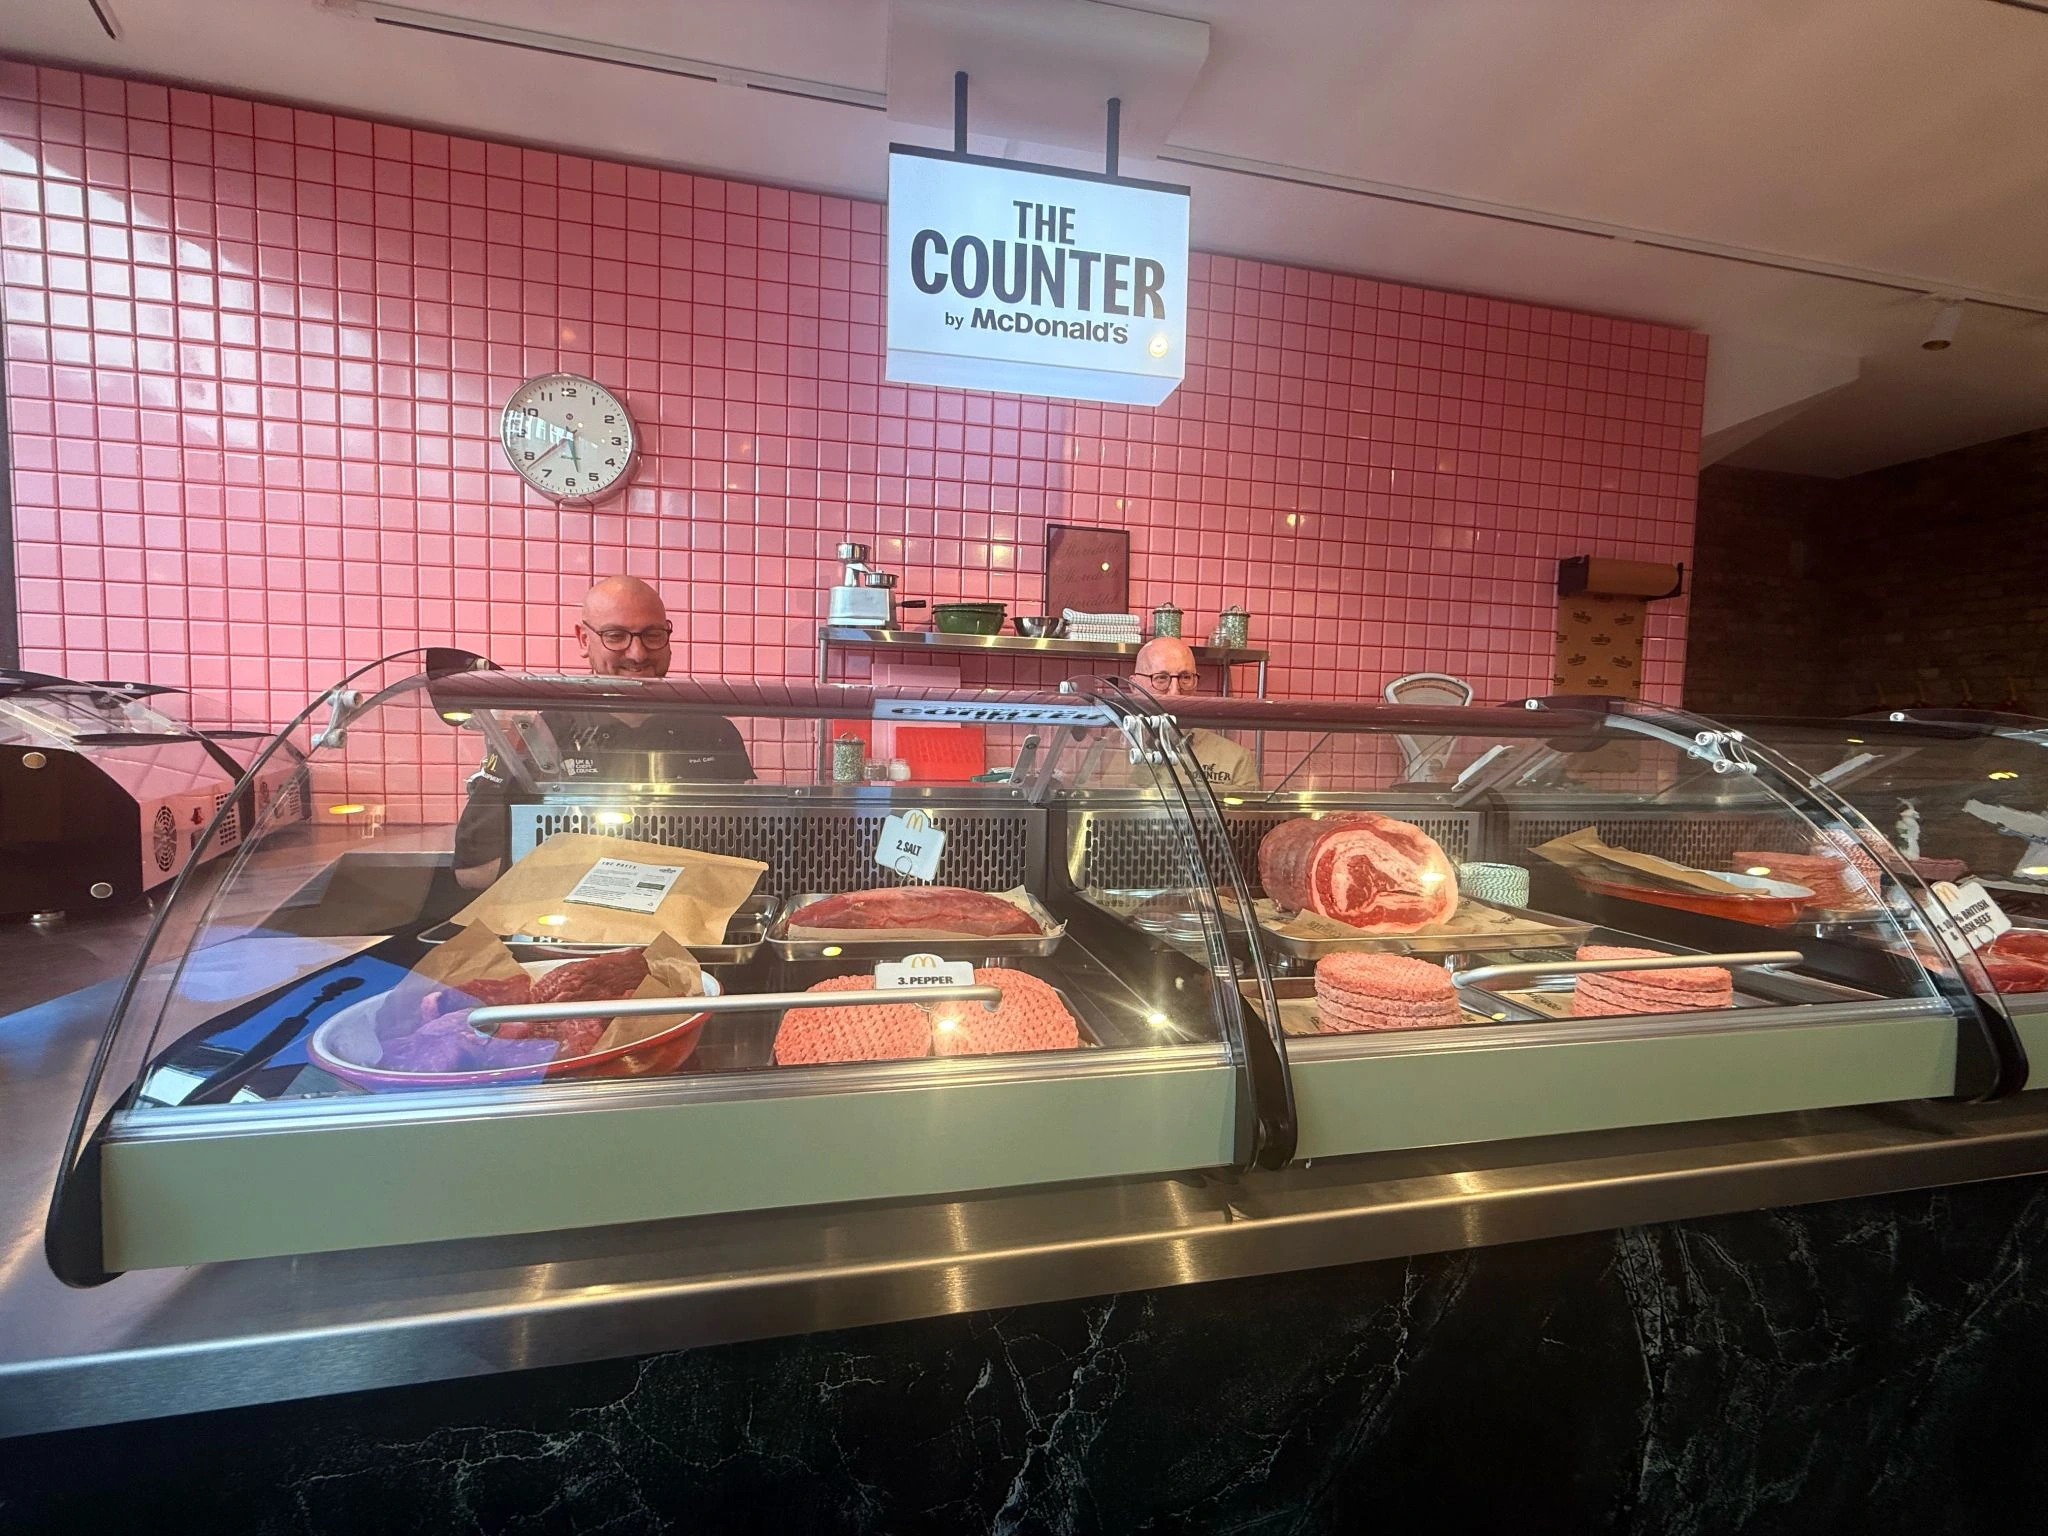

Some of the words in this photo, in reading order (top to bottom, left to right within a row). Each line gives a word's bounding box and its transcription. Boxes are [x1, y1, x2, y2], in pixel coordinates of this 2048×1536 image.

[1013, 200, 1076, 246] THE
[911, 228, 1166, 321] COUNTER
[945, 311, 964, 331] by
[970, 307, 1129, 345] McDonald's
[541, 391, 553, 402] 11
[592, 397, 596, 406] 1
[522, 407, 539, 418] 10
[604, 414, 615, 425] 2
[611, 436, 622, 446] 3
[524, 451, 535, 461] 8
[604, 457, 616, 467] 4
[541, 468, 553, 478] 7
[588, 472, 599, 482] 5
[565, 477, 576, 487] 6
[1192, 770, 1231, 781] ONTER
[903, 841, 923, 857] SALT
[1960, 898, 1990, 921] BRITISH
[897, 976, 909, 986] 3.
[909, 975, 954, 986] PEPPER
